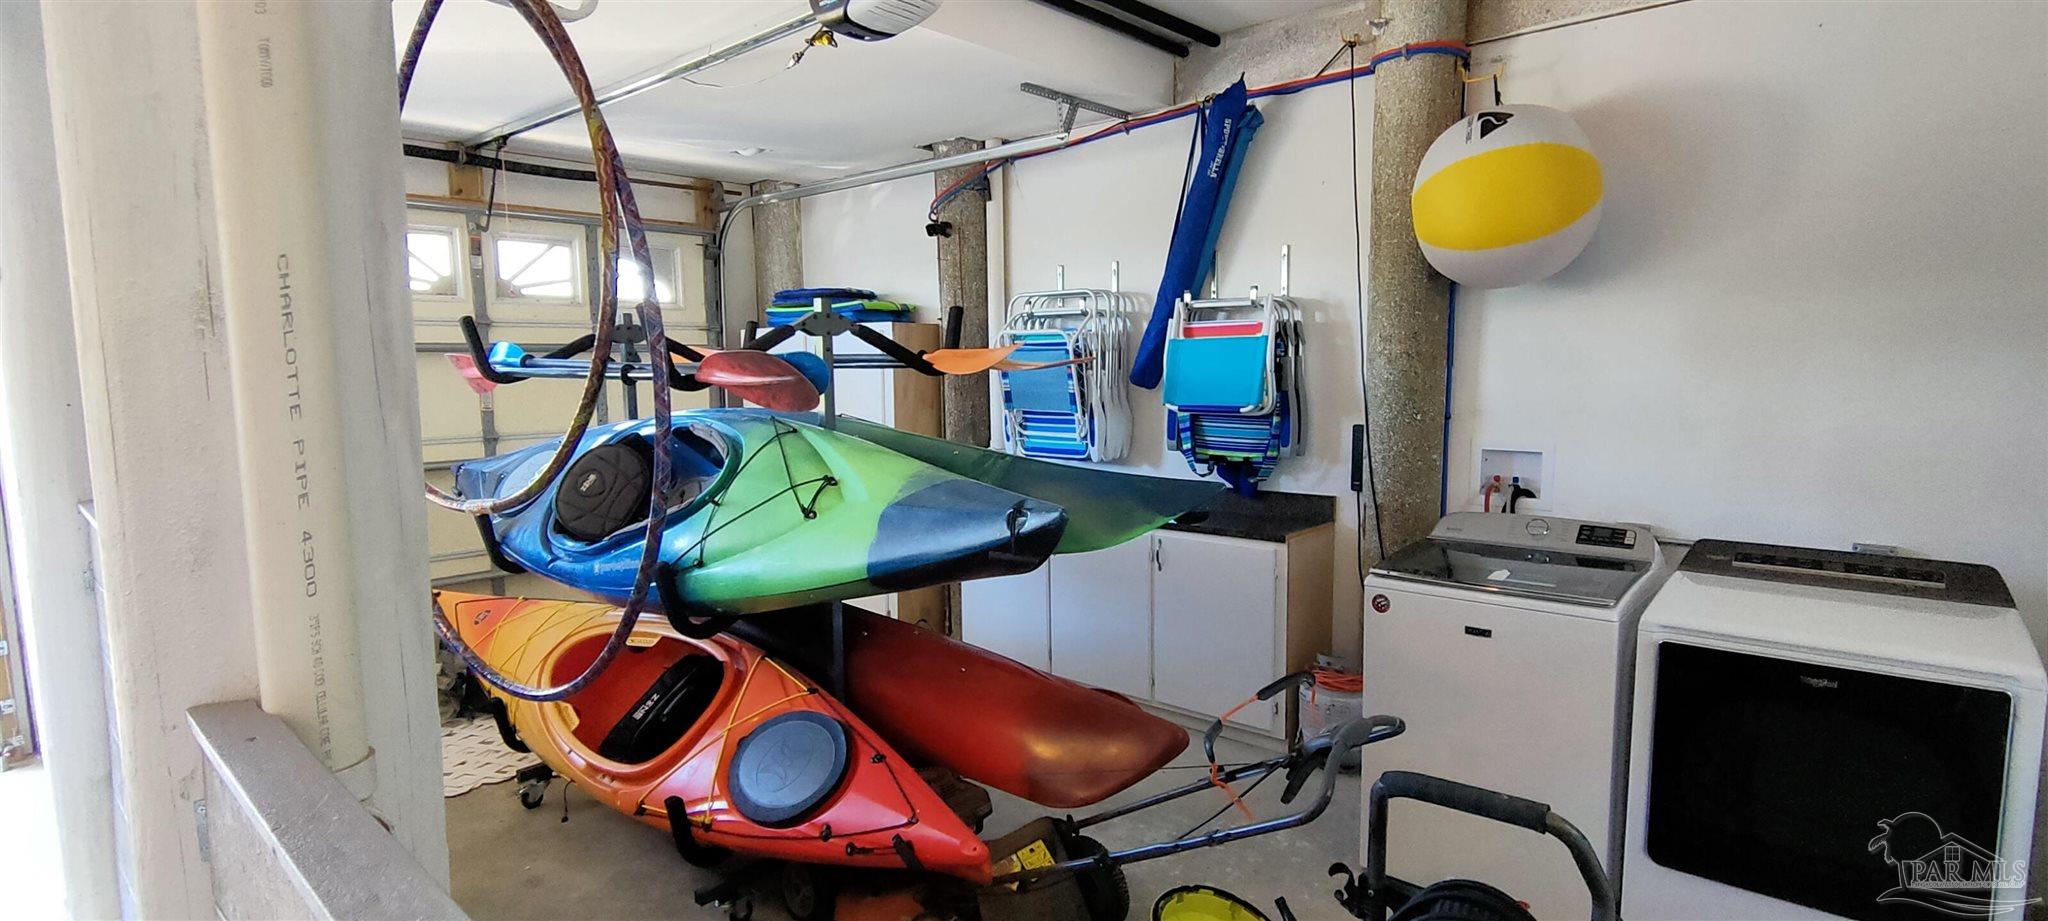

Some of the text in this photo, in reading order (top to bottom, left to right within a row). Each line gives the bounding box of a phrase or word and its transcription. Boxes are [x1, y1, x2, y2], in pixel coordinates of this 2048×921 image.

[277, 253, 302, 421] CHARLOTTE
[293, 438, 310, 510] PIPE
[300, 530, 318, 598] 4300
